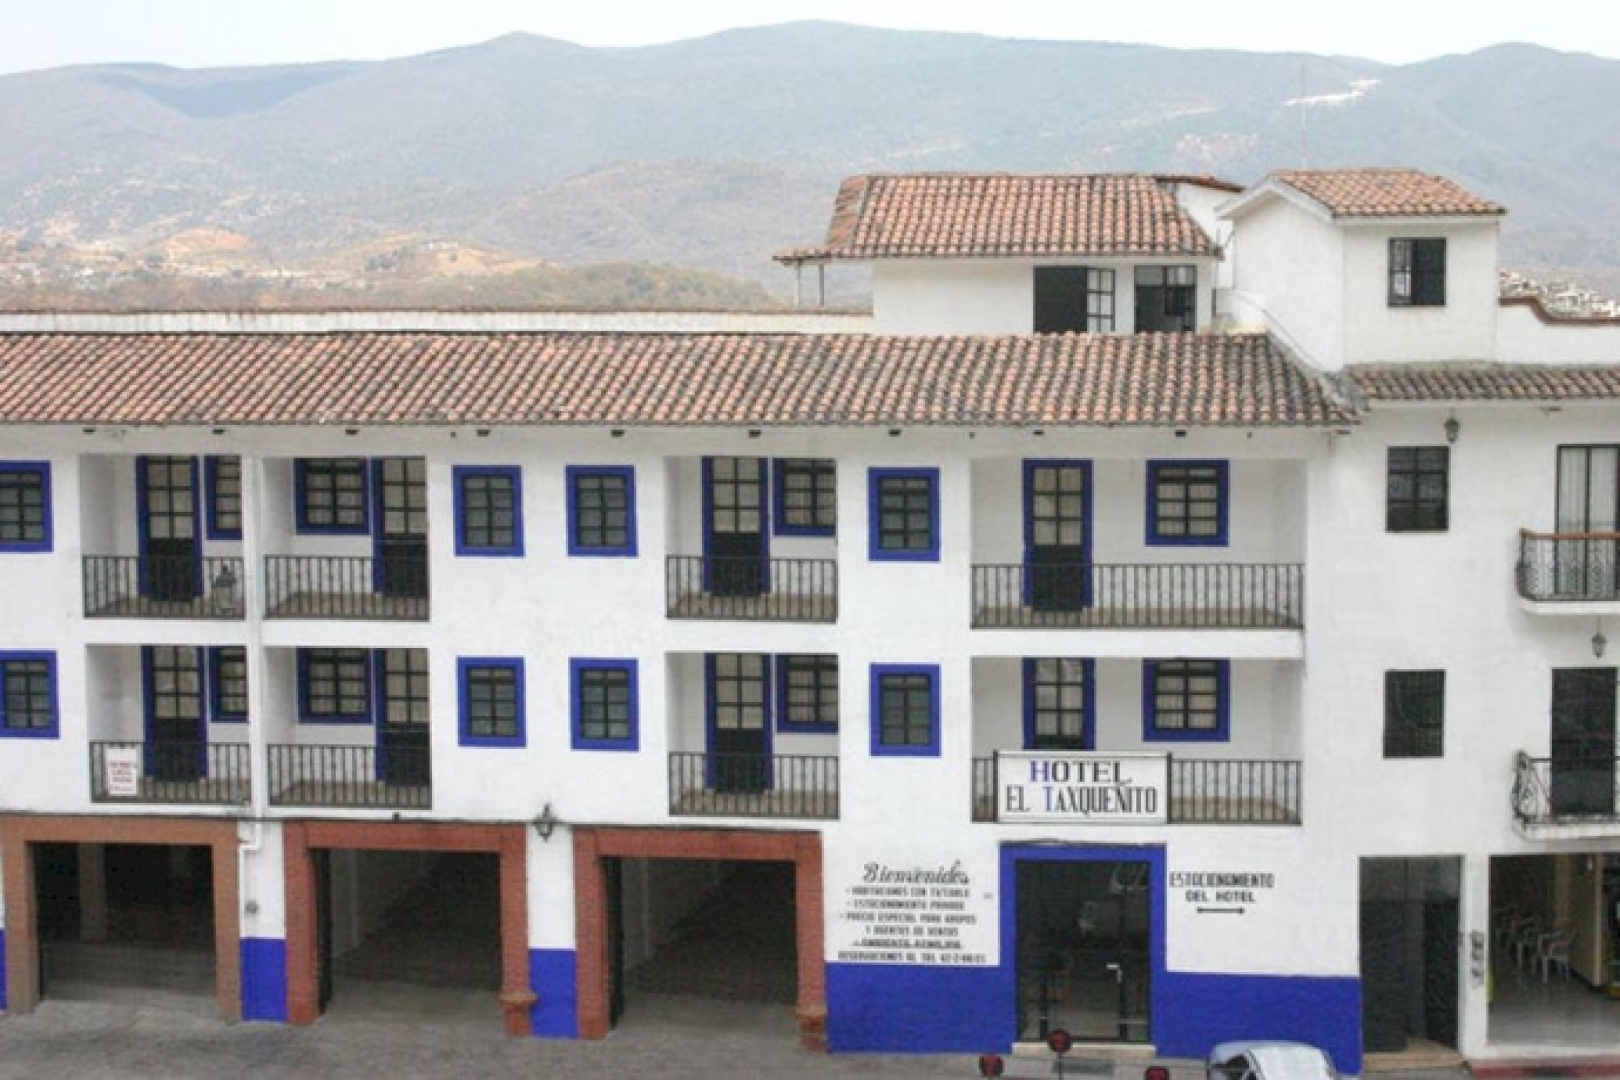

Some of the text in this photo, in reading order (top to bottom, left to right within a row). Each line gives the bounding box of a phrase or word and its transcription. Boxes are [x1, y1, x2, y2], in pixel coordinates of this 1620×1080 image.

[1030, 760, 1132, 783] HOTEL
[1006, 786, 1031, 812] EL
[1185, 890, 1256, 902] DEL HOTEL
